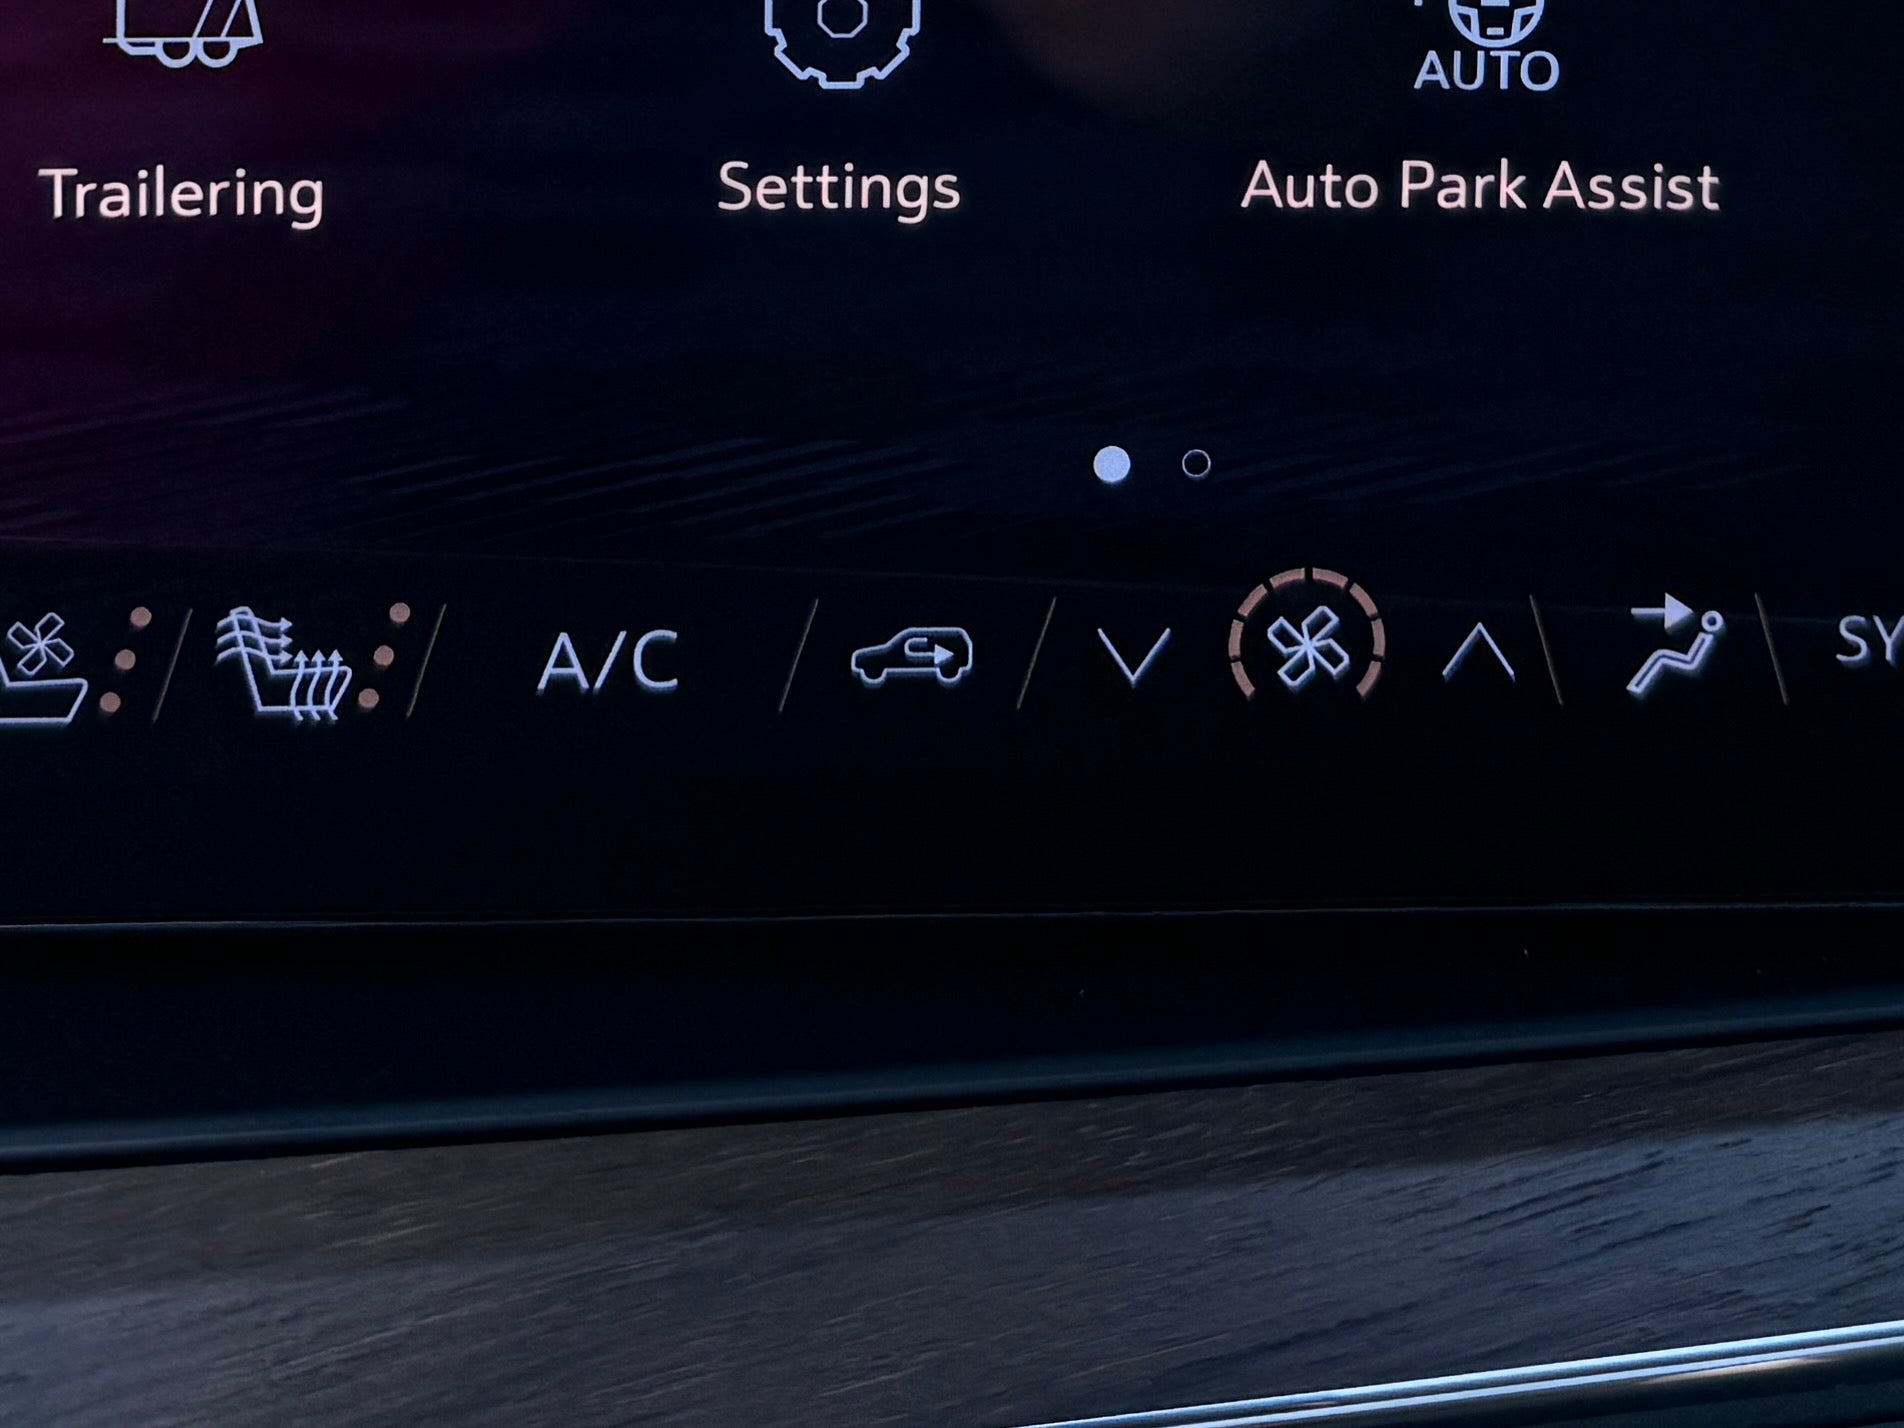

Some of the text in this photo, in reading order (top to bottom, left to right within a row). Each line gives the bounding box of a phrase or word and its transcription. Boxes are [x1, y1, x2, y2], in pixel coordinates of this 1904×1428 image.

[1414, 49, 1560, 92] AUTO
[37, 164, 323, 230] Trailering
[718, 160, 961, 225] Settings
[1241, 157, 1720, 212] Auto Park Assist
[537, 628, 679, 692] A/C
